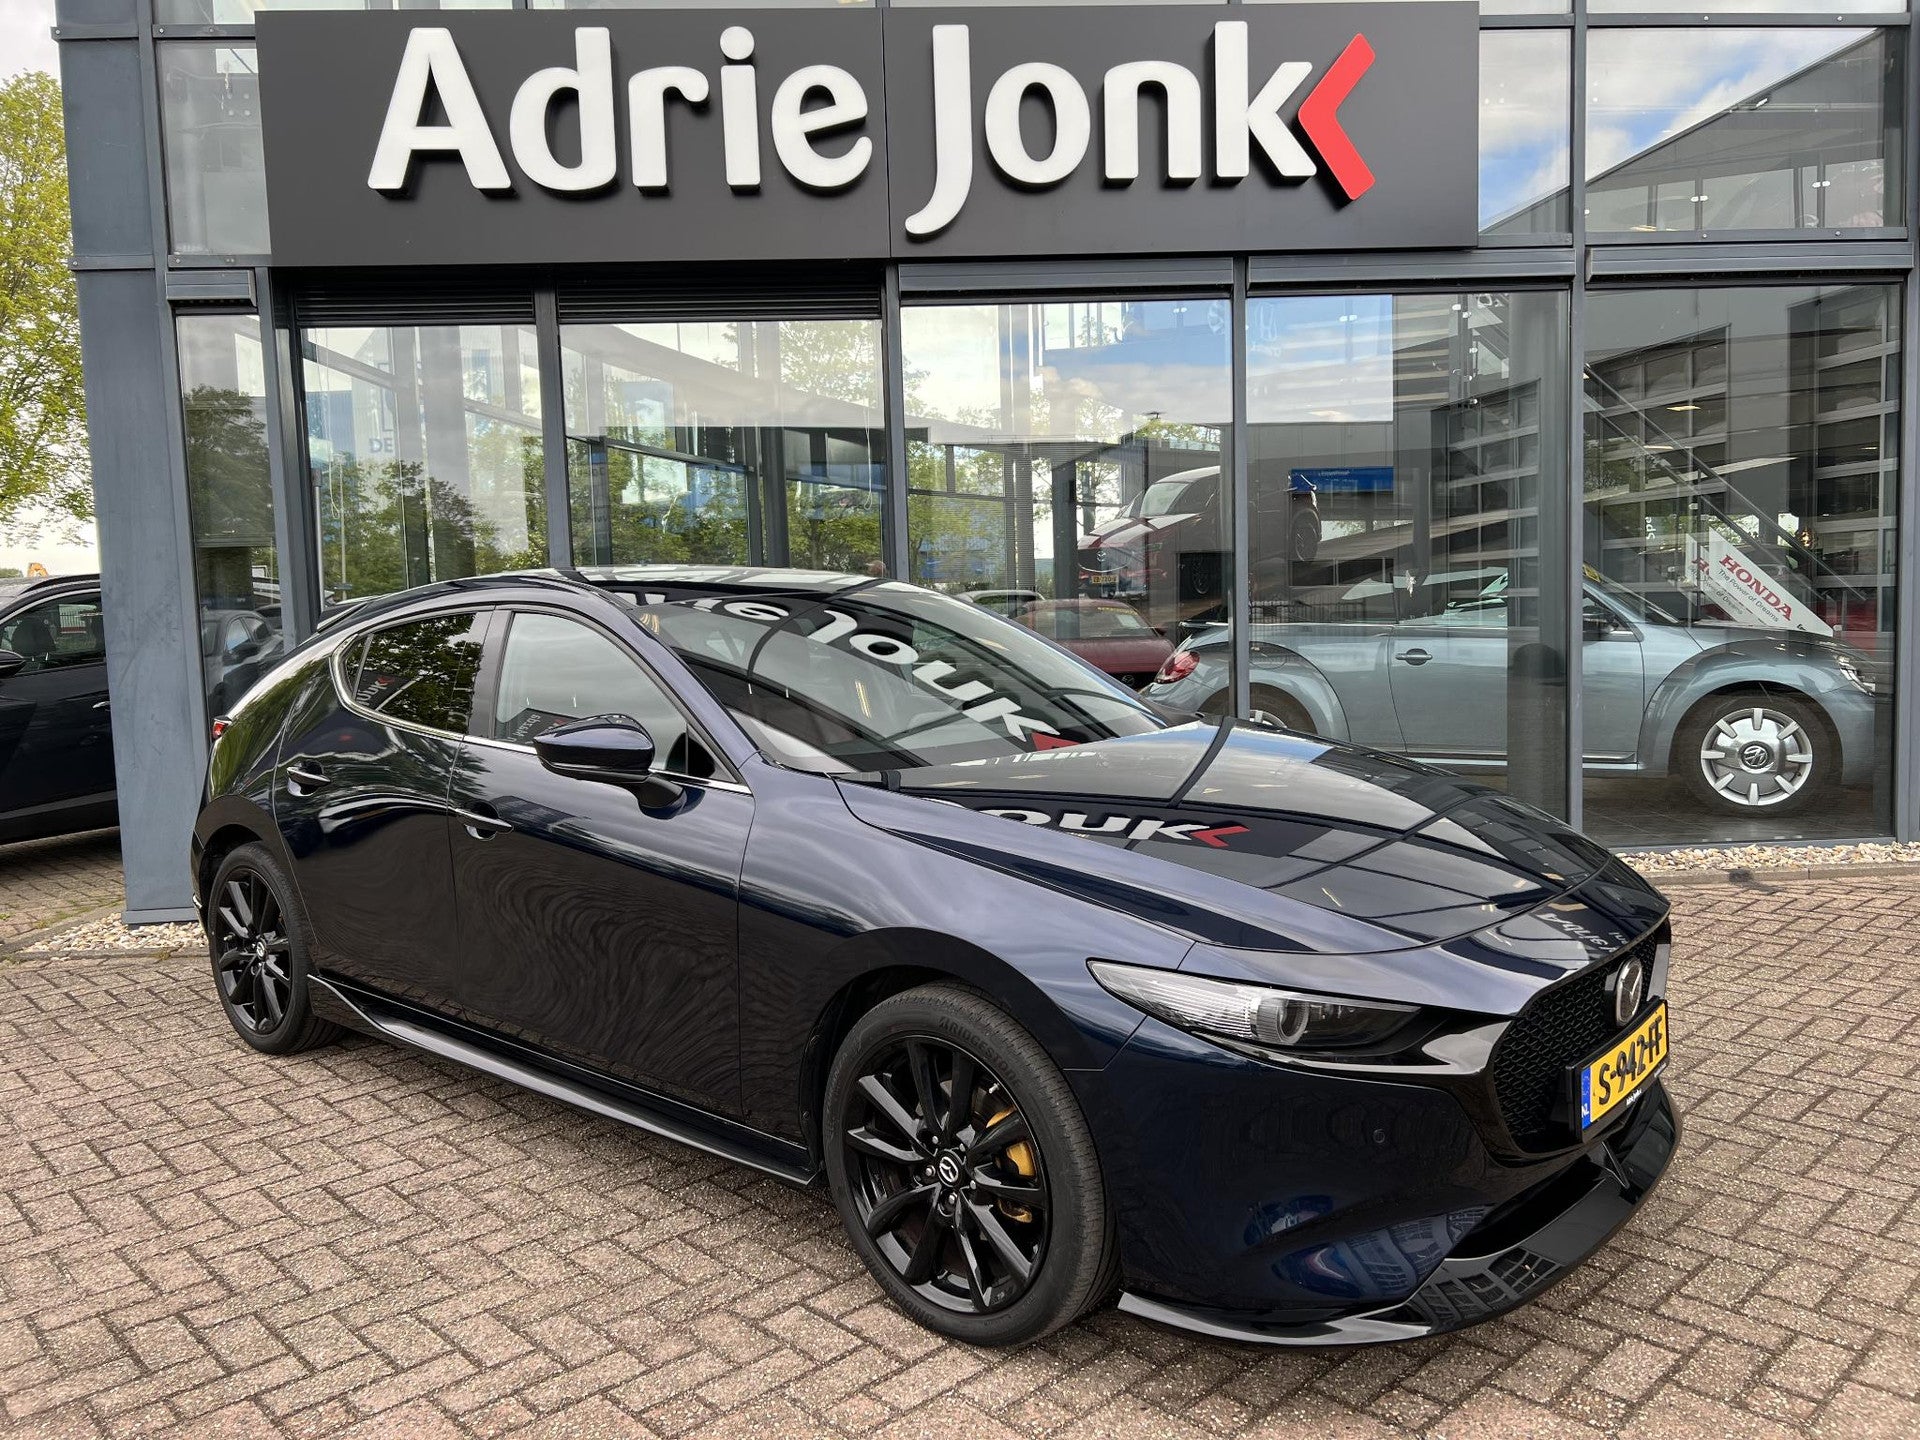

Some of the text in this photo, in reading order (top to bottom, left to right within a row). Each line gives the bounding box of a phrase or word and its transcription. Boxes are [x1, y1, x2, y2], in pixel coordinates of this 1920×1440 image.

[367, 21, 1318, 240] Adrie Jonk
[1718, 568, 1731, 581] The
[1730, 579, 1750, 596] Power
[1748, 594, 1758, 604] of
[1755, 599, 1780, 623] Dreams
[1719, 554, 1793, 622] HONDA
[1581, 1102, 1590, 1119] NL
